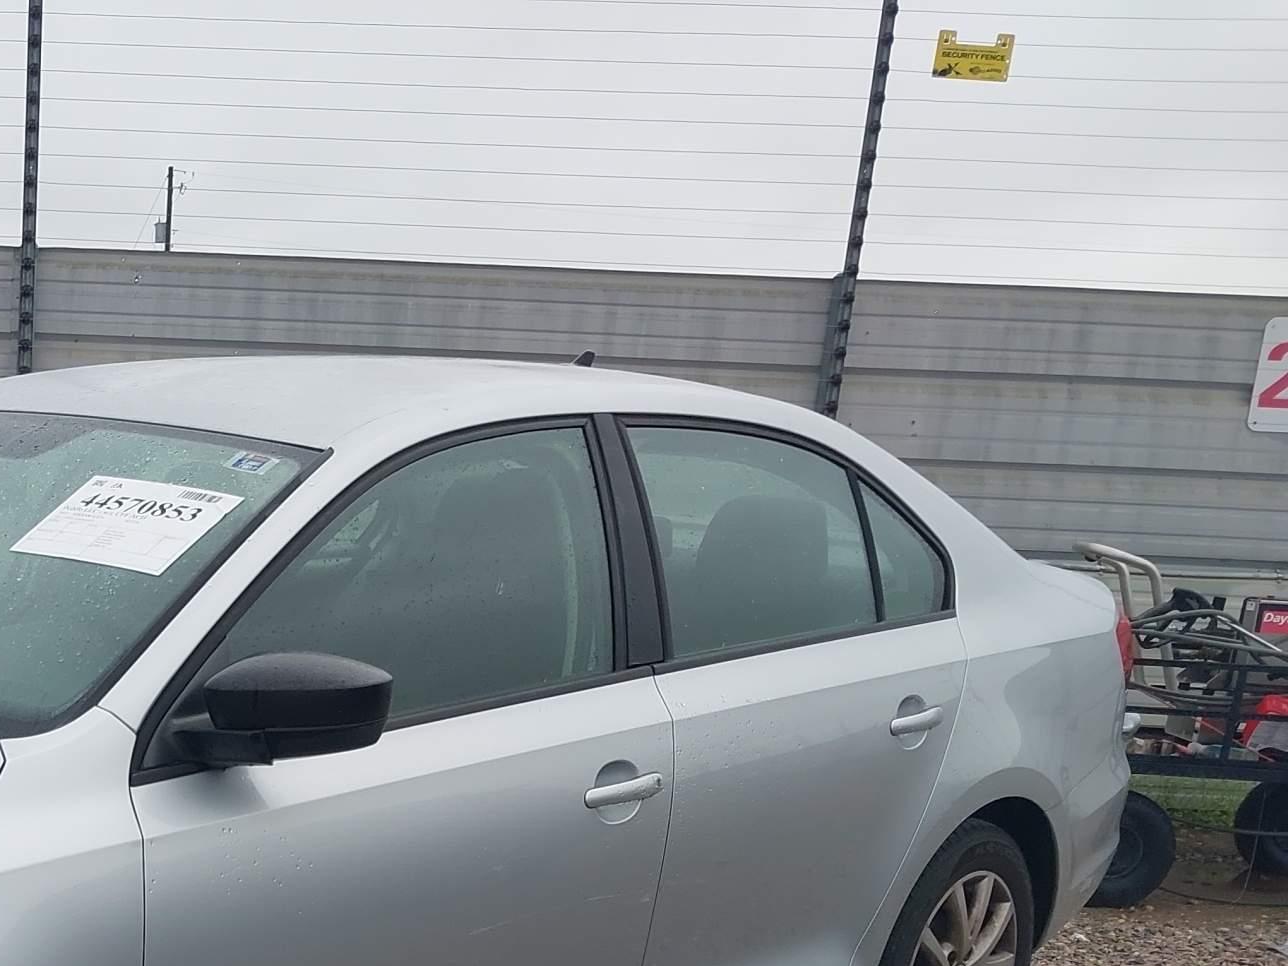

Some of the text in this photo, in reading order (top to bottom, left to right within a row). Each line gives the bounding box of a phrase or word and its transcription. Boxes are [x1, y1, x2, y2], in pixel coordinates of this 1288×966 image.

[941, 51, 1007, 62] SECURITY FENCE
[1257, 340, 1288, 408] 2
[80, 493, 202, 522] 44570853
[1263, 612, 1288, 626] Day
